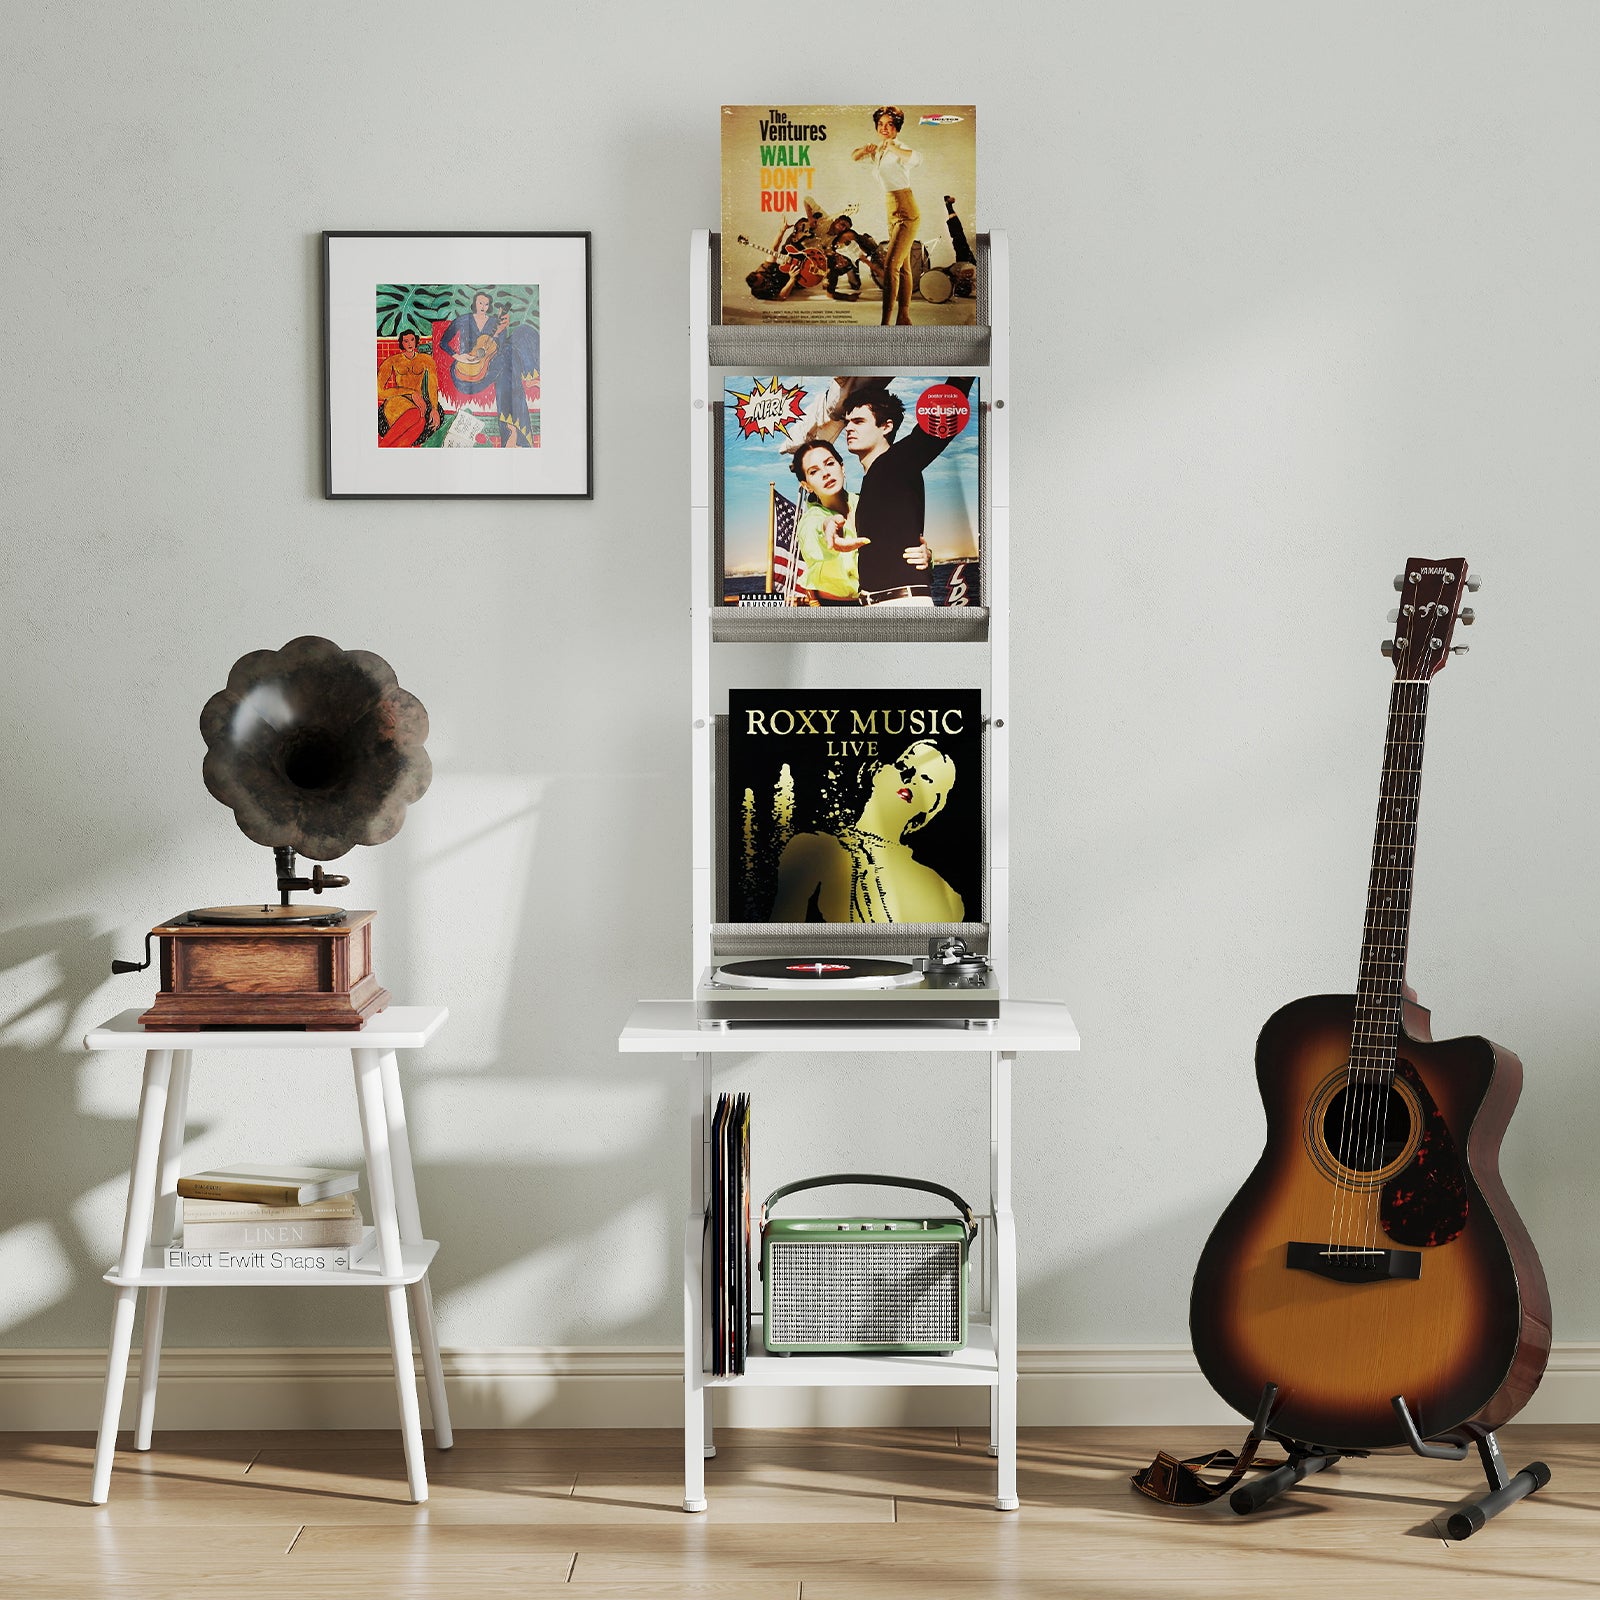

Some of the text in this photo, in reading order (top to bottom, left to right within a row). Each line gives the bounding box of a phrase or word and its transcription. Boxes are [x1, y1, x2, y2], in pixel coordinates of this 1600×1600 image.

[769, 109, 788, 124] The
[759, 119, 827, 142] Ventures
[760, 145, 811, 167] WALK
[760, 167, 816, 190] DON'T
[761, 191, 798, 213] RUN
[917, 404, 969, 416] exclusive
[745, 709, 964, 736] ROXY MUSIC
[827, 741, 879, 757] LIVE
[244, 1226, 304, 1243] LINEN
[169, 1251, 326, 1271] Elliott Erwitt Snaps
